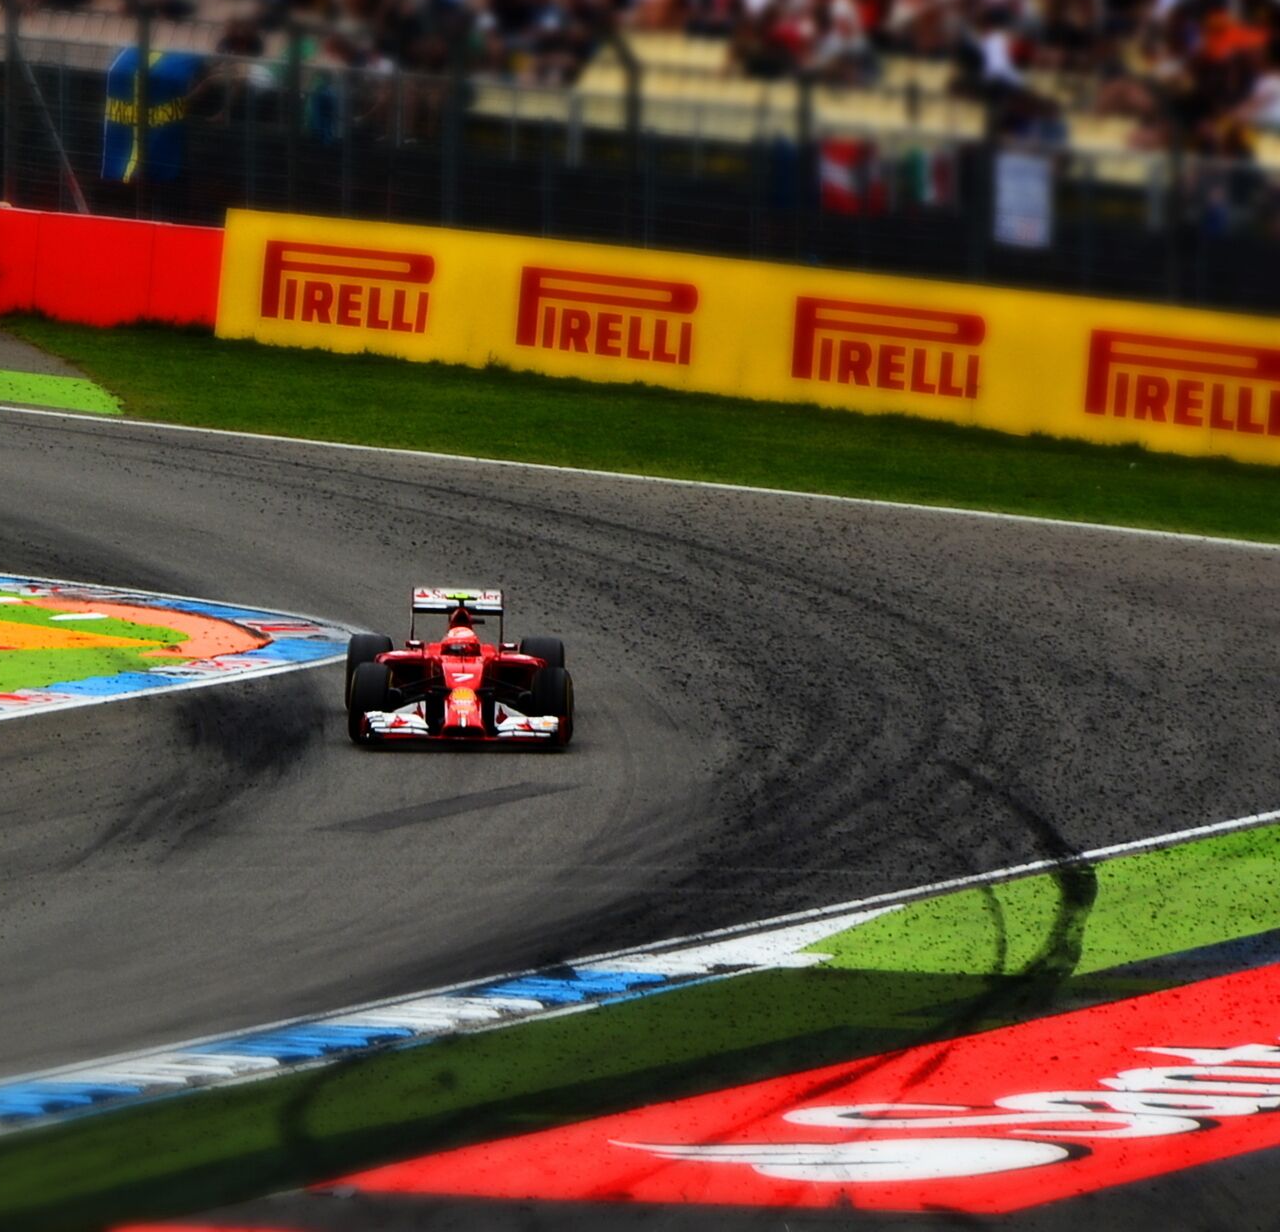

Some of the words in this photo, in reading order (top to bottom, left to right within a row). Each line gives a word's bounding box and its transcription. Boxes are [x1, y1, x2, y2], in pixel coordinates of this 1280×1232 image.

[260, 240, 435, 334] PIRELLI
[515, 266, 698, 365] PIRELLI
[791, 296, 986, 399] PIRELLI
[1083, 329, 1280, 437] PIRELLI
[451, 672, 474, 682] 7
